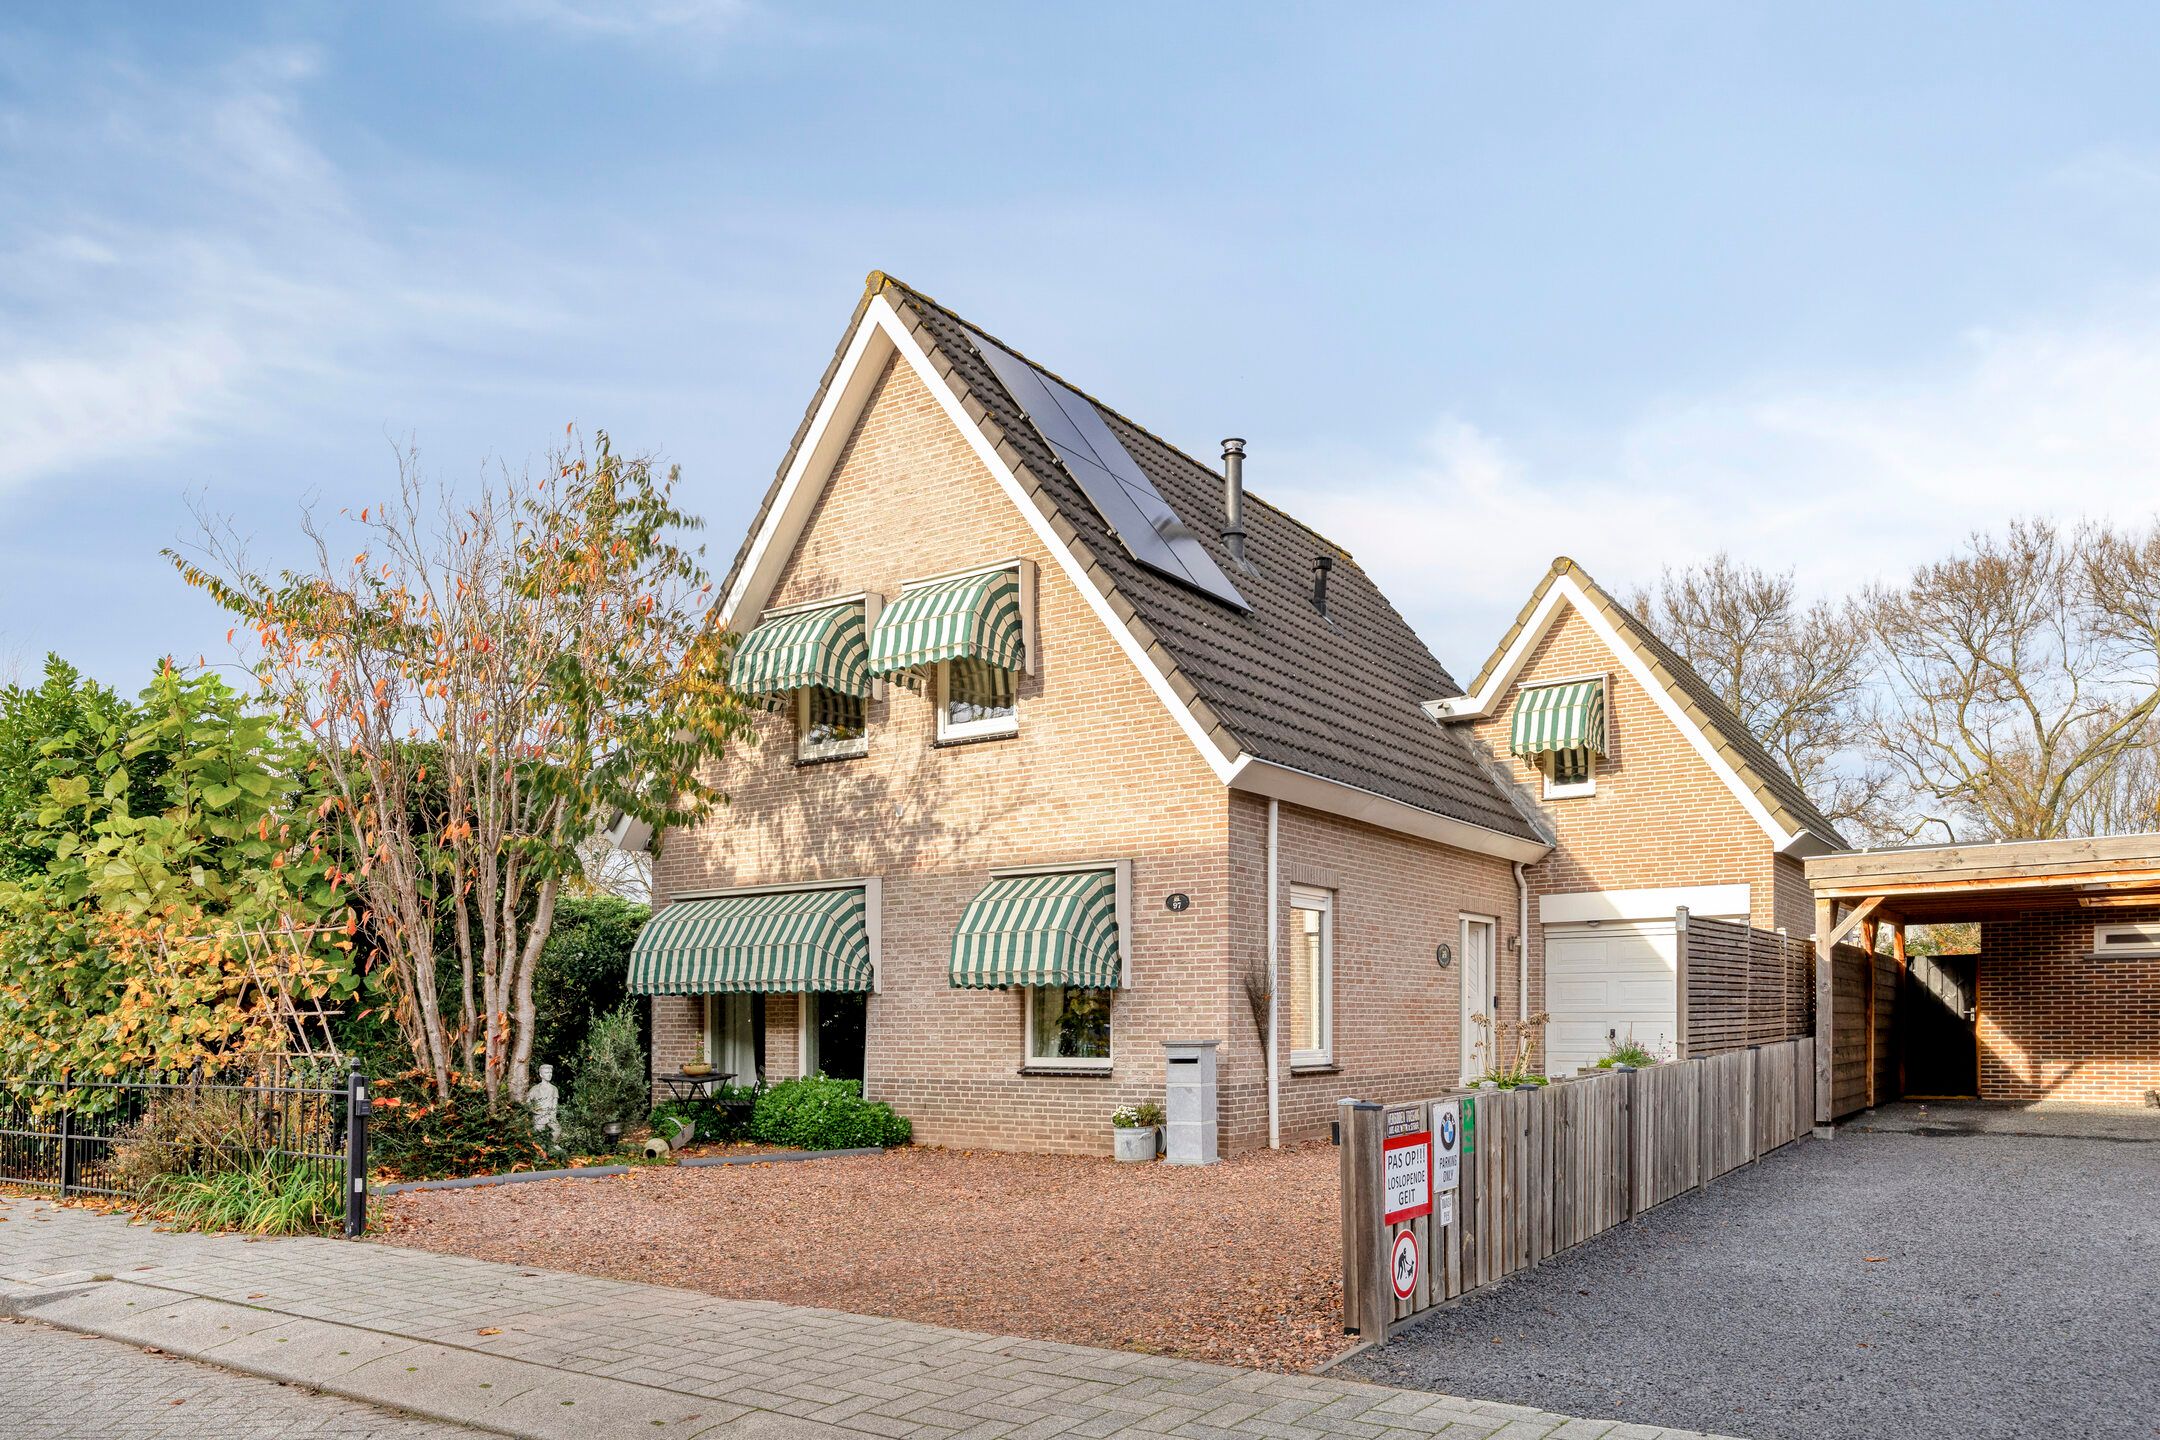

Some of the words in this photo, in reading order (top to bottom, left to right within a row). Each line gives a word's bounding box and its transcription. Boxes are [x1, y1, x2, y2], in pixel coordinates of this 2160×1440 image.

[1172, 902, 1182, 910] 97
[1388, 1153, 1402, 1170] PAS
[1405, 1148, 1425, 1167] OP!!!
[1440, 1154, 1457, 1169] PARKING
[1388, 1170, 1425, 1190] LOSLOPENDE
[1443, 1170, 1454, 1182] ONLY
[1398, 1188, 1416, 1206] GEIT
